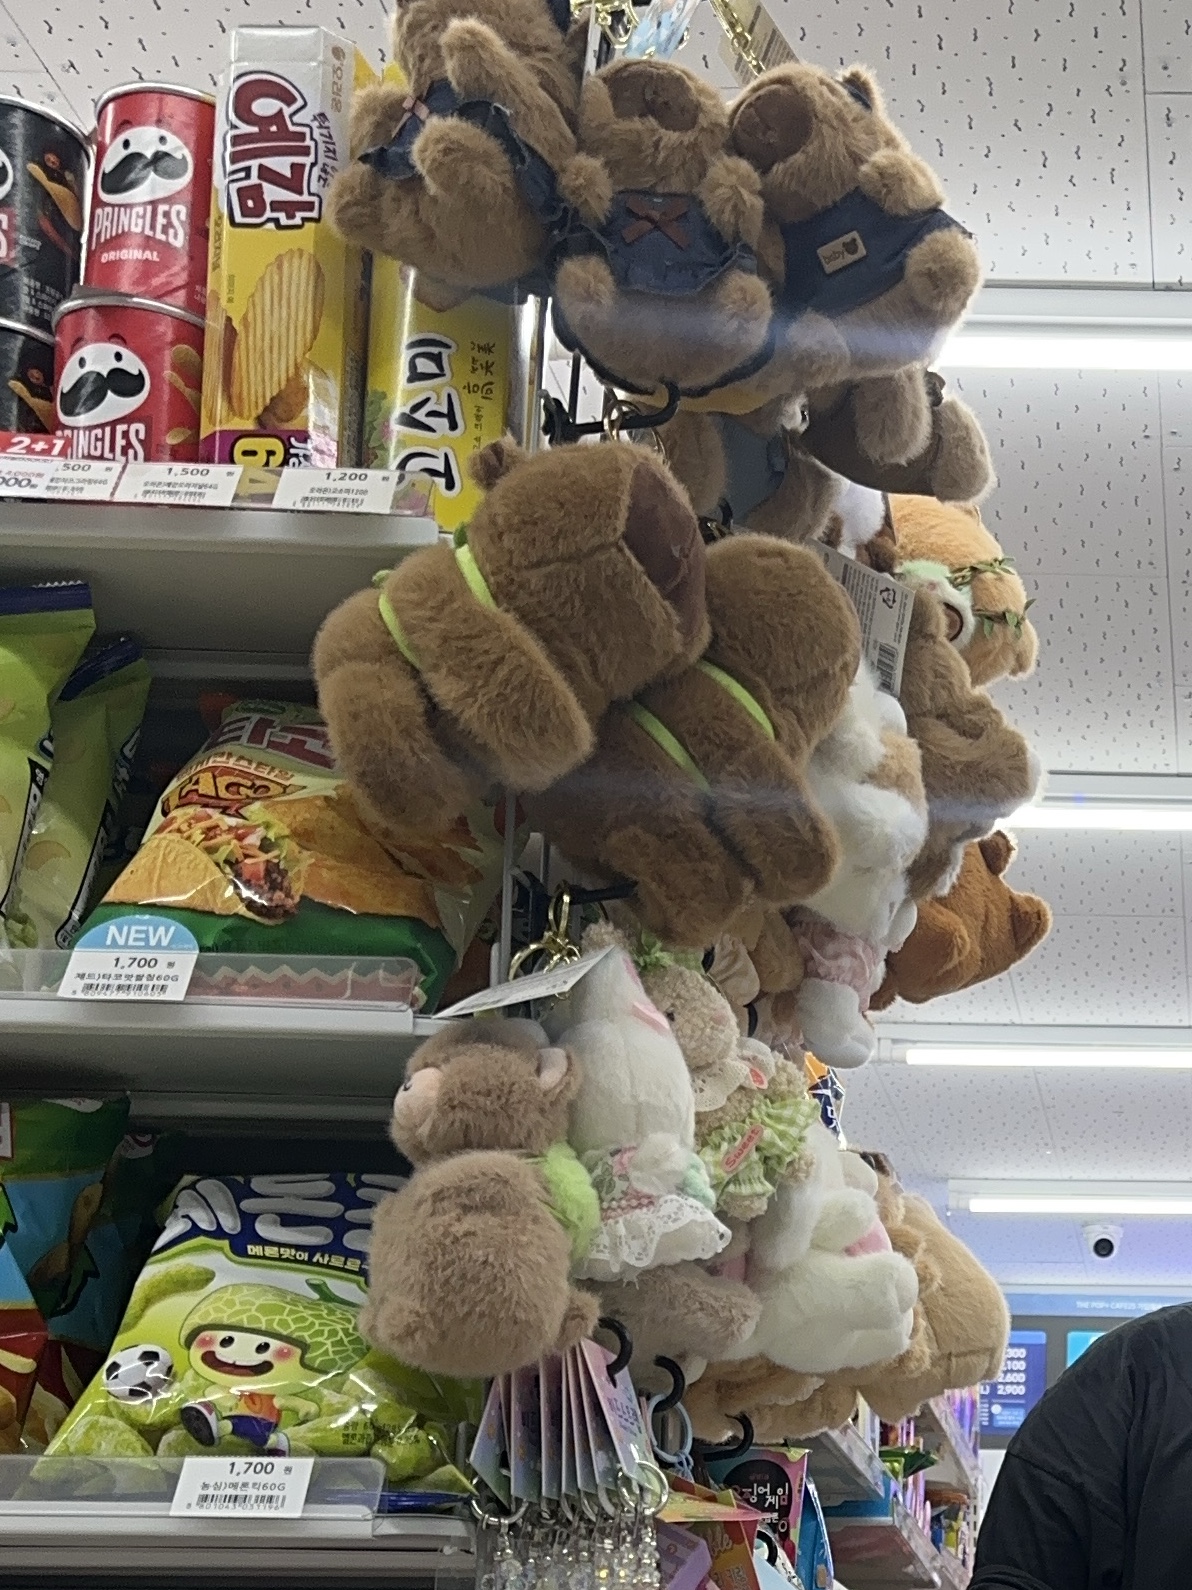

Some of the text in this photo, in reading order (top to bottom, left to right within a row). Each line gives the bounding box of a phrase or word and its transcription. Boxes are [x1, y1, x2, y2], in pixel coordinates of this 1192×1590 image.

[228, 75, 318, 225] 예감
[91, 204, 188, 251] PRINGLES
[101, 250, 160, 263] ORIGINAL
[394, 337, 459, 492] 고소미
[6, 436, 66, 456] 2+1
[166, 467, 210, 477] 1,500
[325, 472, 368, 482] 1,200
[105, 925, 176, 946] NEW
[113, 957, 159, 970] 1,700
[228, 1461, 275, 1476] 1,700
